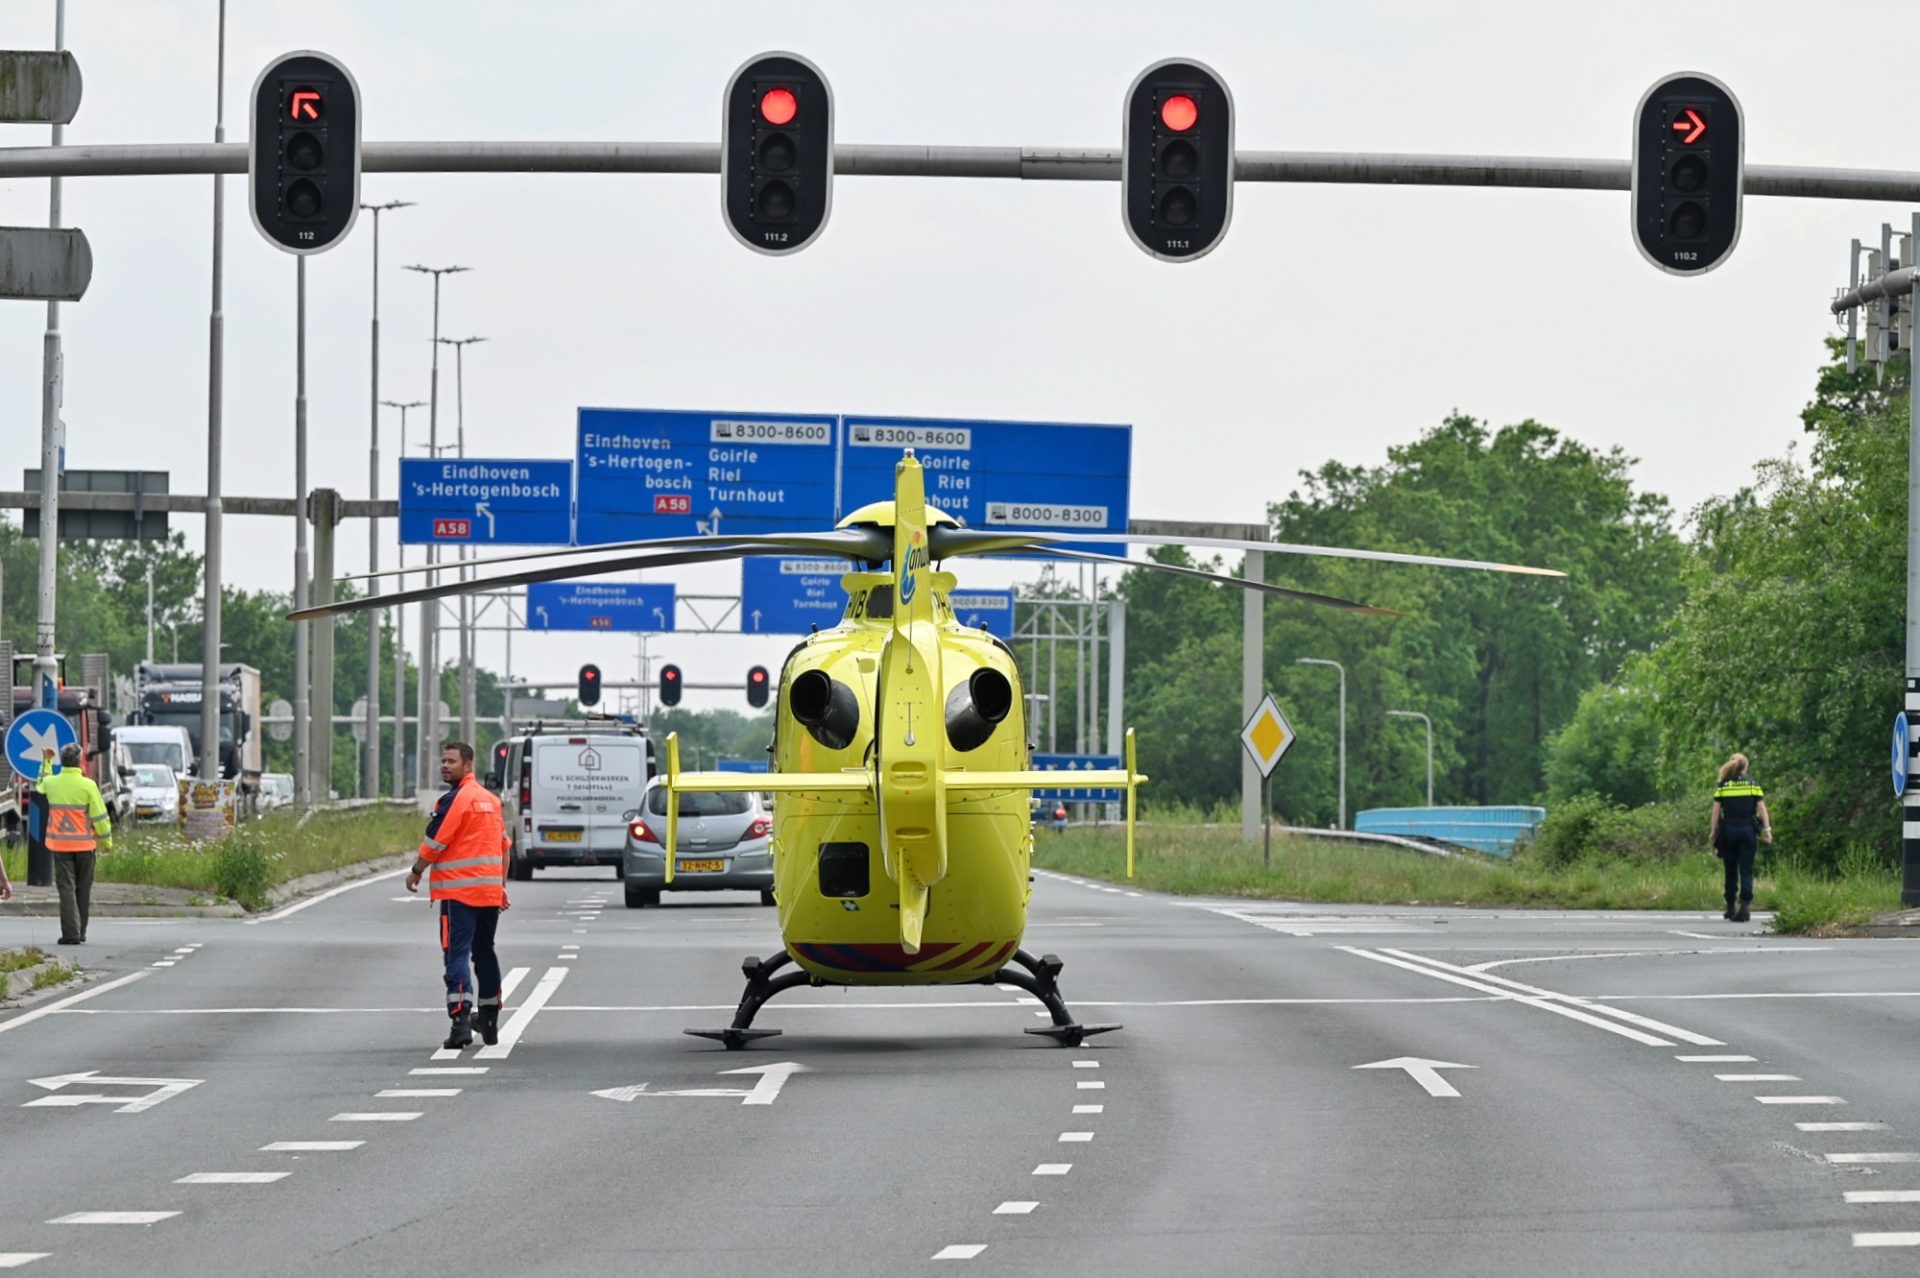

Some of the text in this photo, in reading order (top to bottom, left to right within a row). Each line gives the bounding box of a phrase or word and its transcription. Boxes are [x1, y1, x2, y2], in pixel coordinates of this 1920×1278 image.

[298, 231, 314, 240] 112
[764, 232, 788, 242] 111.2
[1166, 240, 1189, 248] 111.1
[1674, 252, 1697, 260] 110.2
[735, 425, 826, 439] 8300-8600
[874, 429, 966, 445] 8300-8600
[584, 433, 671, 450] Eindhoven
[584, 453, 693, 473] 's-Hertogen-
[708, 448, 758, 463] Goirle
[921, 455, 970, 470] Goirle
[442, 465, 530, 480] Eindhoven
[708, 467, 741, 482] Riel
[645, 475, 692, 490] bosch
[938, 475, 971, 490] Riel
[412, 482, 560, 500] 's-Hertogenbosch
[708, 487, 785, 503] Turnhout
[1011, 507, 1102, 522] 8000-8300
[436, 522, 467, 535] A58
[908, 547, 931, 571] anw
[801, 577, 831, 586] Goirle
[575, 586, 627, 595] Eindhoven
[806, 589, 825, 597] Riel
[793, 599, 838, 609] Turnhout
